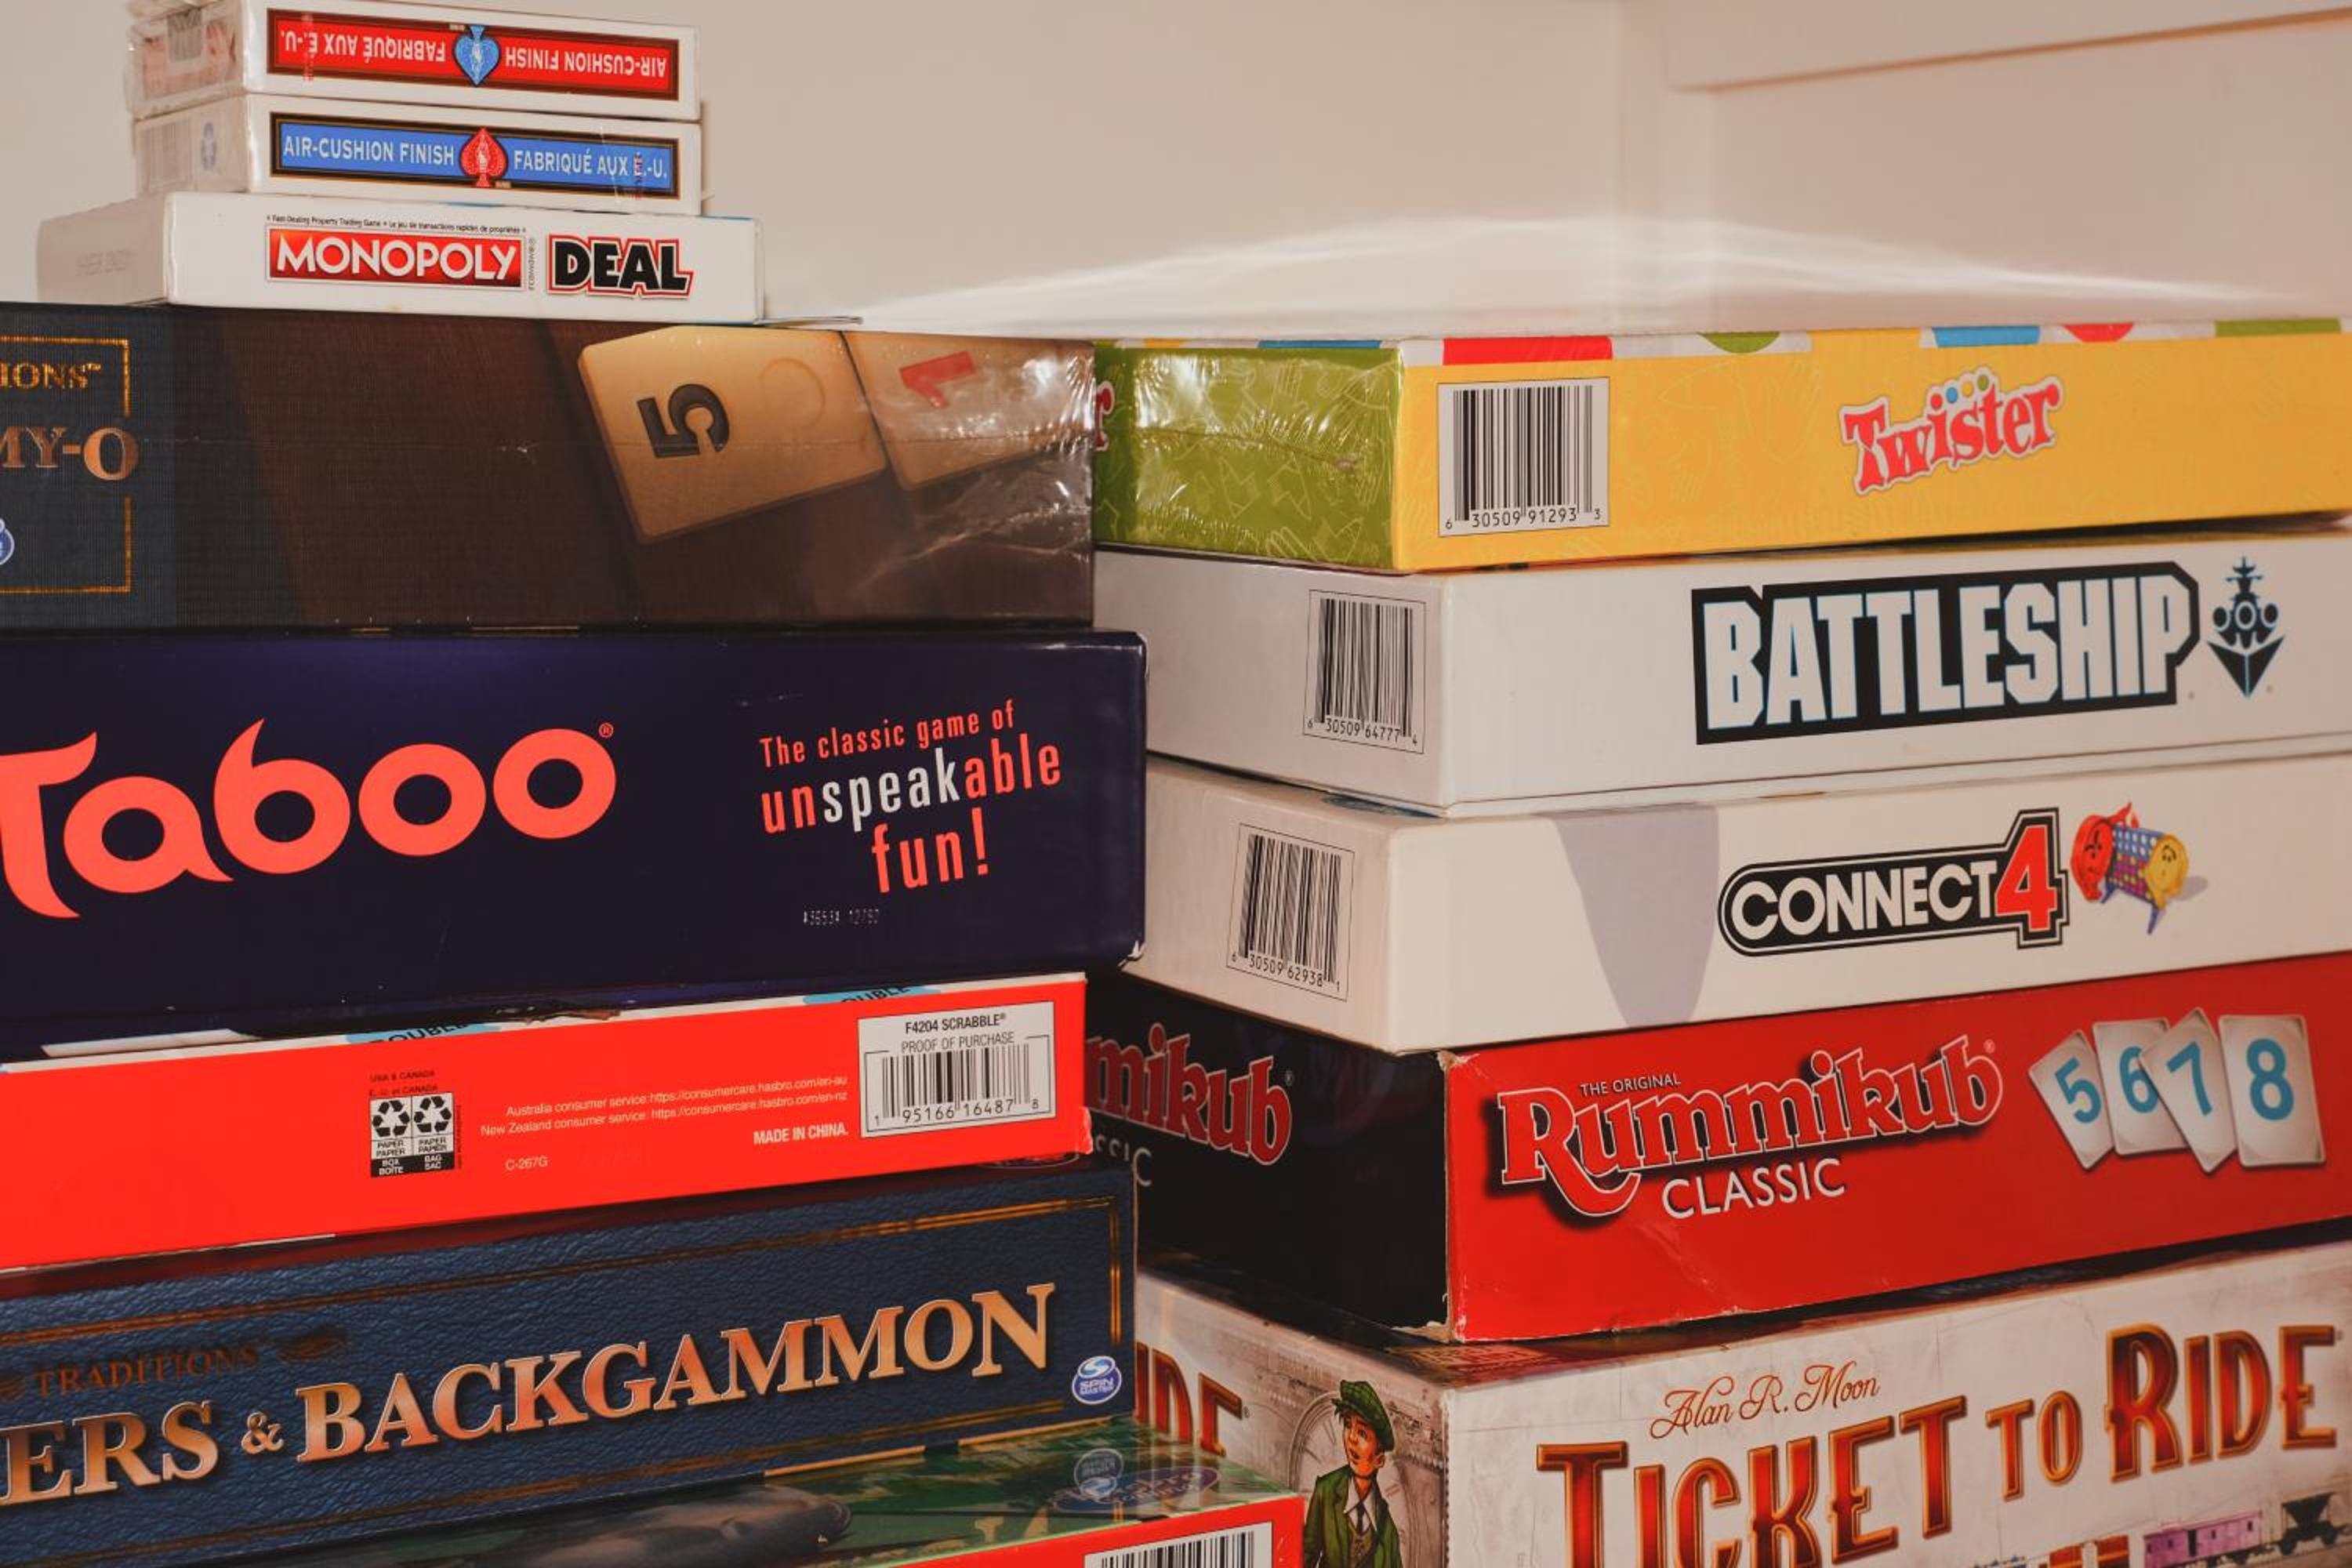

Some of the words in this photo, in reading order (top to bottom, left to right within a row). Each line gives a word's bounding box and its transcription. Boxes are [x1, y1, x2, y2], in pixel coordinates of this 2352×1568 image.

[324, 34, 358, 55] AUX
[506, 46, 559, 71] FINISH
[564, 52, 666, 78] AIR-CUSHION
[284, 135, 394, 162] AIR-CUSHION
[399, 143, 455, 166] FINISH
[514, 148, 593, 176] FABRIQUÉ
[596, 154, 629, 177] AUX
[275, 235, 517, 281] MONOPOLY
[552, 238, 691, 294] DEAL
[1839, 374, 2063, 494] Twister
[1472, 506, 1522, 529] 30509
[1527, 504, 1578, 524] 91293
[1593, 507, 1601, 522] 3
[1702, 574, 2194, 731] BATTLESHIP
[759, 736, 806, 768] The
[818, 718, 906, 759] classic
[916, 710, 980, 749] game
[991, 698, 1016, 731] of
[1326, 718, 1360, 737] 30509
[760, 732, 1062, 833] unspeakable
[871, 808, 989, 893] fun!
[1730, 859, 1998, 940] CONNECT
[1994, 824, 2059, 931] 4
[901, 1039, 938, 1053] PROOF
[941, 1037, 956, 1050] OF
[958, 1031, 1015, 1048] PURCHASE
[905, 1020, 938, 1034] F4204
[1580, 1080, 1608, 1098] THE
[1612, 1072, 1682, 1095] ORIGINAL
[2054, 1056, 2103, 1124] 5
[2118, 1045, 2160, 1113] 6
[2165, 1041, 2213, 1117] 7
[2245, 1038, 2295, 1121] 8
[480, 1125, 506, 1137] New
[508, 1120, 552, 1134] Zealand
[554, 1116, 605, 1129] consumer
[506, 1102, 553, 1116] Australia
[554, 1099, 607, 1112] consumer
[902, 1106, 955, 1123] 95166
[963, 1099, 1014, 1117] 16487
[753, 1128, 789, 1145] MADE
[792, 1127, 806, 1142] IN
[808, 1121, 849, 1140] CHINA.
[1661, 1156, 1846, 1220] CLASSIC
[34, 1343, 260, 1398] TRADITIONS
[240, 1411, 285, 1454] &
[296, 1282, 1056, 1463] BACKGAMMON
[1650, 1375, 1735, 1439] Alan
[1739, 1374, 1789, 1421] R.
[1794, 1360, 1881, 1412] Moon
[1535, 1394, 1968, 1568] TICKET
[1984, 1389, 2084, 1502] TO
[2103, 1323, 2338, 1483] RIDE
